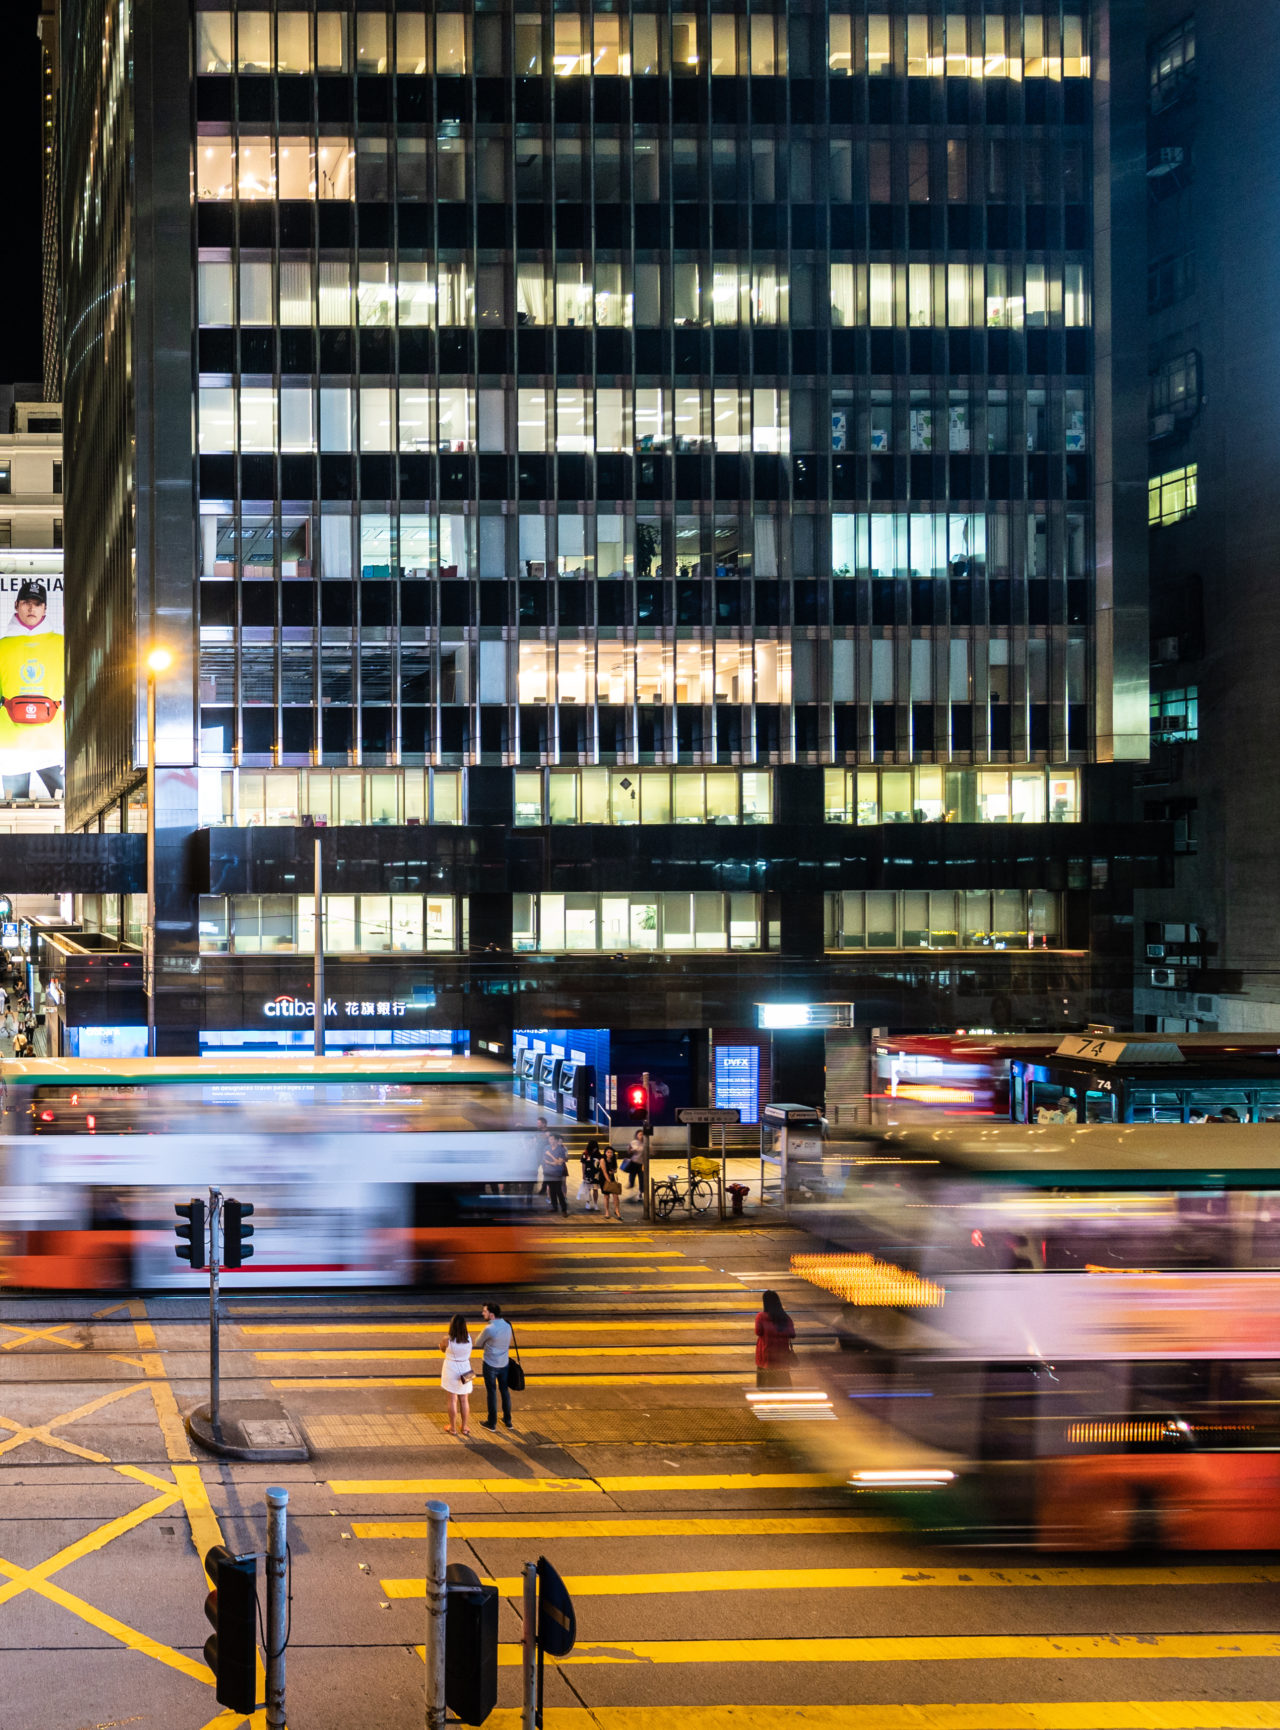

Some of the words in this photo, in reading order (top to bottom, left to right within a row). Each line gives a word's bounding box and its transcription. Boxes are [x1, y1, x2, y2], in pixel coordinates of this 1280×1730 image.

[345, 1001, 407, 1016] 花旗銀行
[1076, 1038, 1106, 1057] 74
[1096, 1079, 1112, 1090] 74
